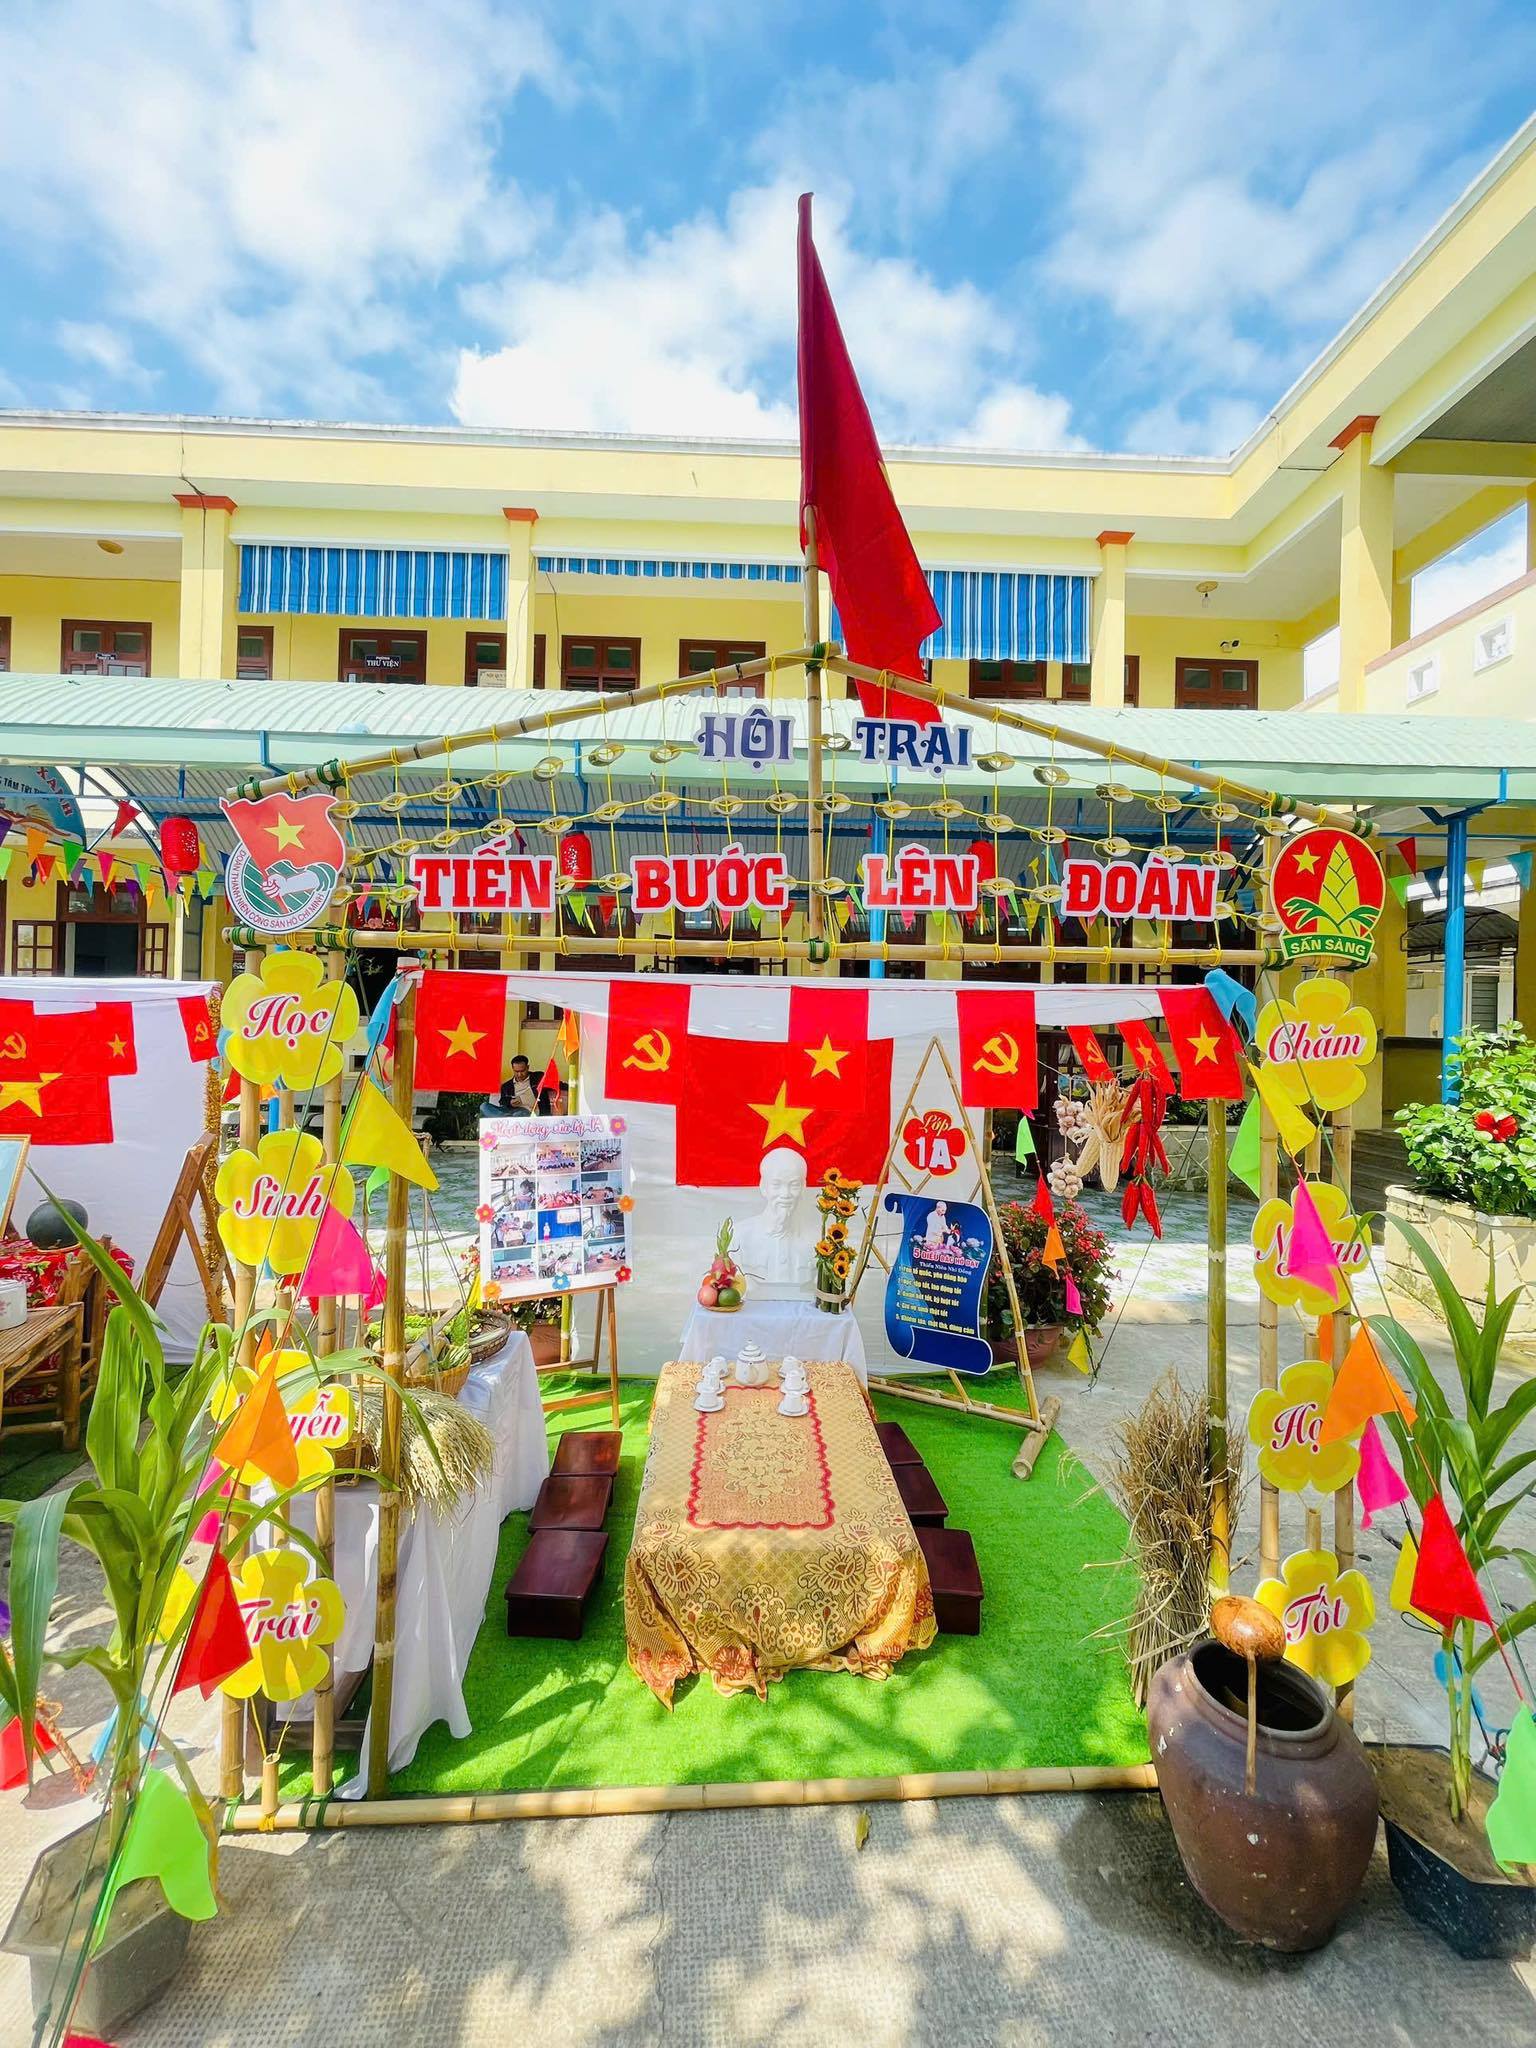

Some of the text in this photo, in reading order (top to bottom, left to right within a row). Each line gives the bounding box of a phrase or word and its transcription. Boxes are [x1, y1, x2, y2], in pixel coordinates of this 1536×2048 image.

[366, 659, 400, 668] THƯ VIỆN
[698, 708, 970, 774] HỘI TRẠI
[414, 839, 1215, 917] TIẾN BƯỚC LÊN ĐOÀN
[1325, 938, 1366, 956] SÀNG
[244, 995, 331, 1047] Học
[1269, 1023, 1365, 1062] Chăm
[920, 1114, 949, 1136] Lớp
[916, 1136, 952, 1169] 1A
[236, 1176, 324, 1216] Sinh
[913, 1248, 920, 1258] 5
[240, 1600, 320, 1643] Trãi
